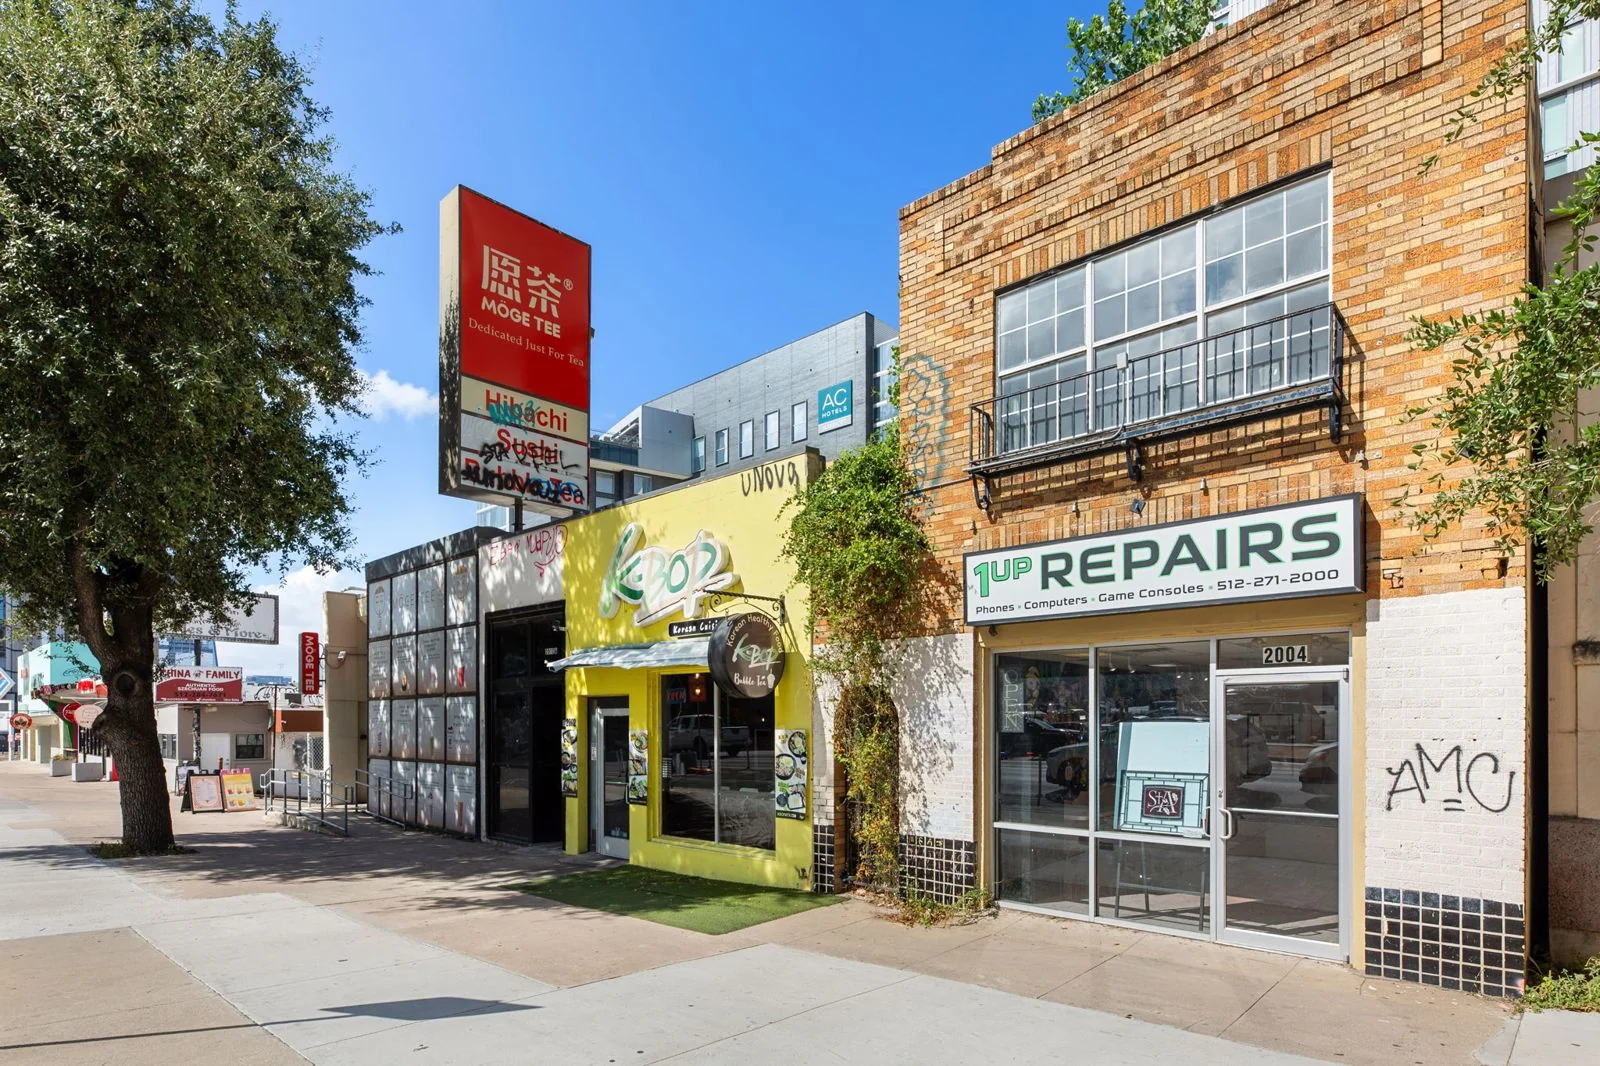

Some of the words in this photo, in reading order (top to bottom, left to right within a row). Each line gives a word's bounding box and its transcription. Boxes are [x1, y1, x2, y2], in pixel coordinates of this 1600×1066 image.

[533, 315, 561, 339] TEE
[468, 317, 522, 346] Dedicated
[526, 338, 545, 354] Just
[548, 346, 565, 361] For
[567, 353, 584, 367] Tea
[822, 388, 848, 411] AC
[821, 405, 848, 419] HOTELS
[497, 428, 559, 464] Sushi
[973, 556, 1033, 598] 1UP
[1041, 512, 1341, 590] REPAIRS
[976, 602, 1015, 615] Phones
[1024, 595, 1088, 610] Computers
[1098, 590, 1135, 603] Game
[1138, 583, 1204, 599] Consoles
[1216, 569, 1339, 591] 512-271-2000
[727, 619, 747, 647] Korean
[747, 614, 774, 631] Healthy
[773, 631, 784, 654] Food
[1263, 645, 1307, 664] 2004
[205, 670, 240, 679] FAMILY
[305, 671, 315, 691] TEE
[734, 672, 754, 686] Bubble
[757, 675, 767, 687] Tea
